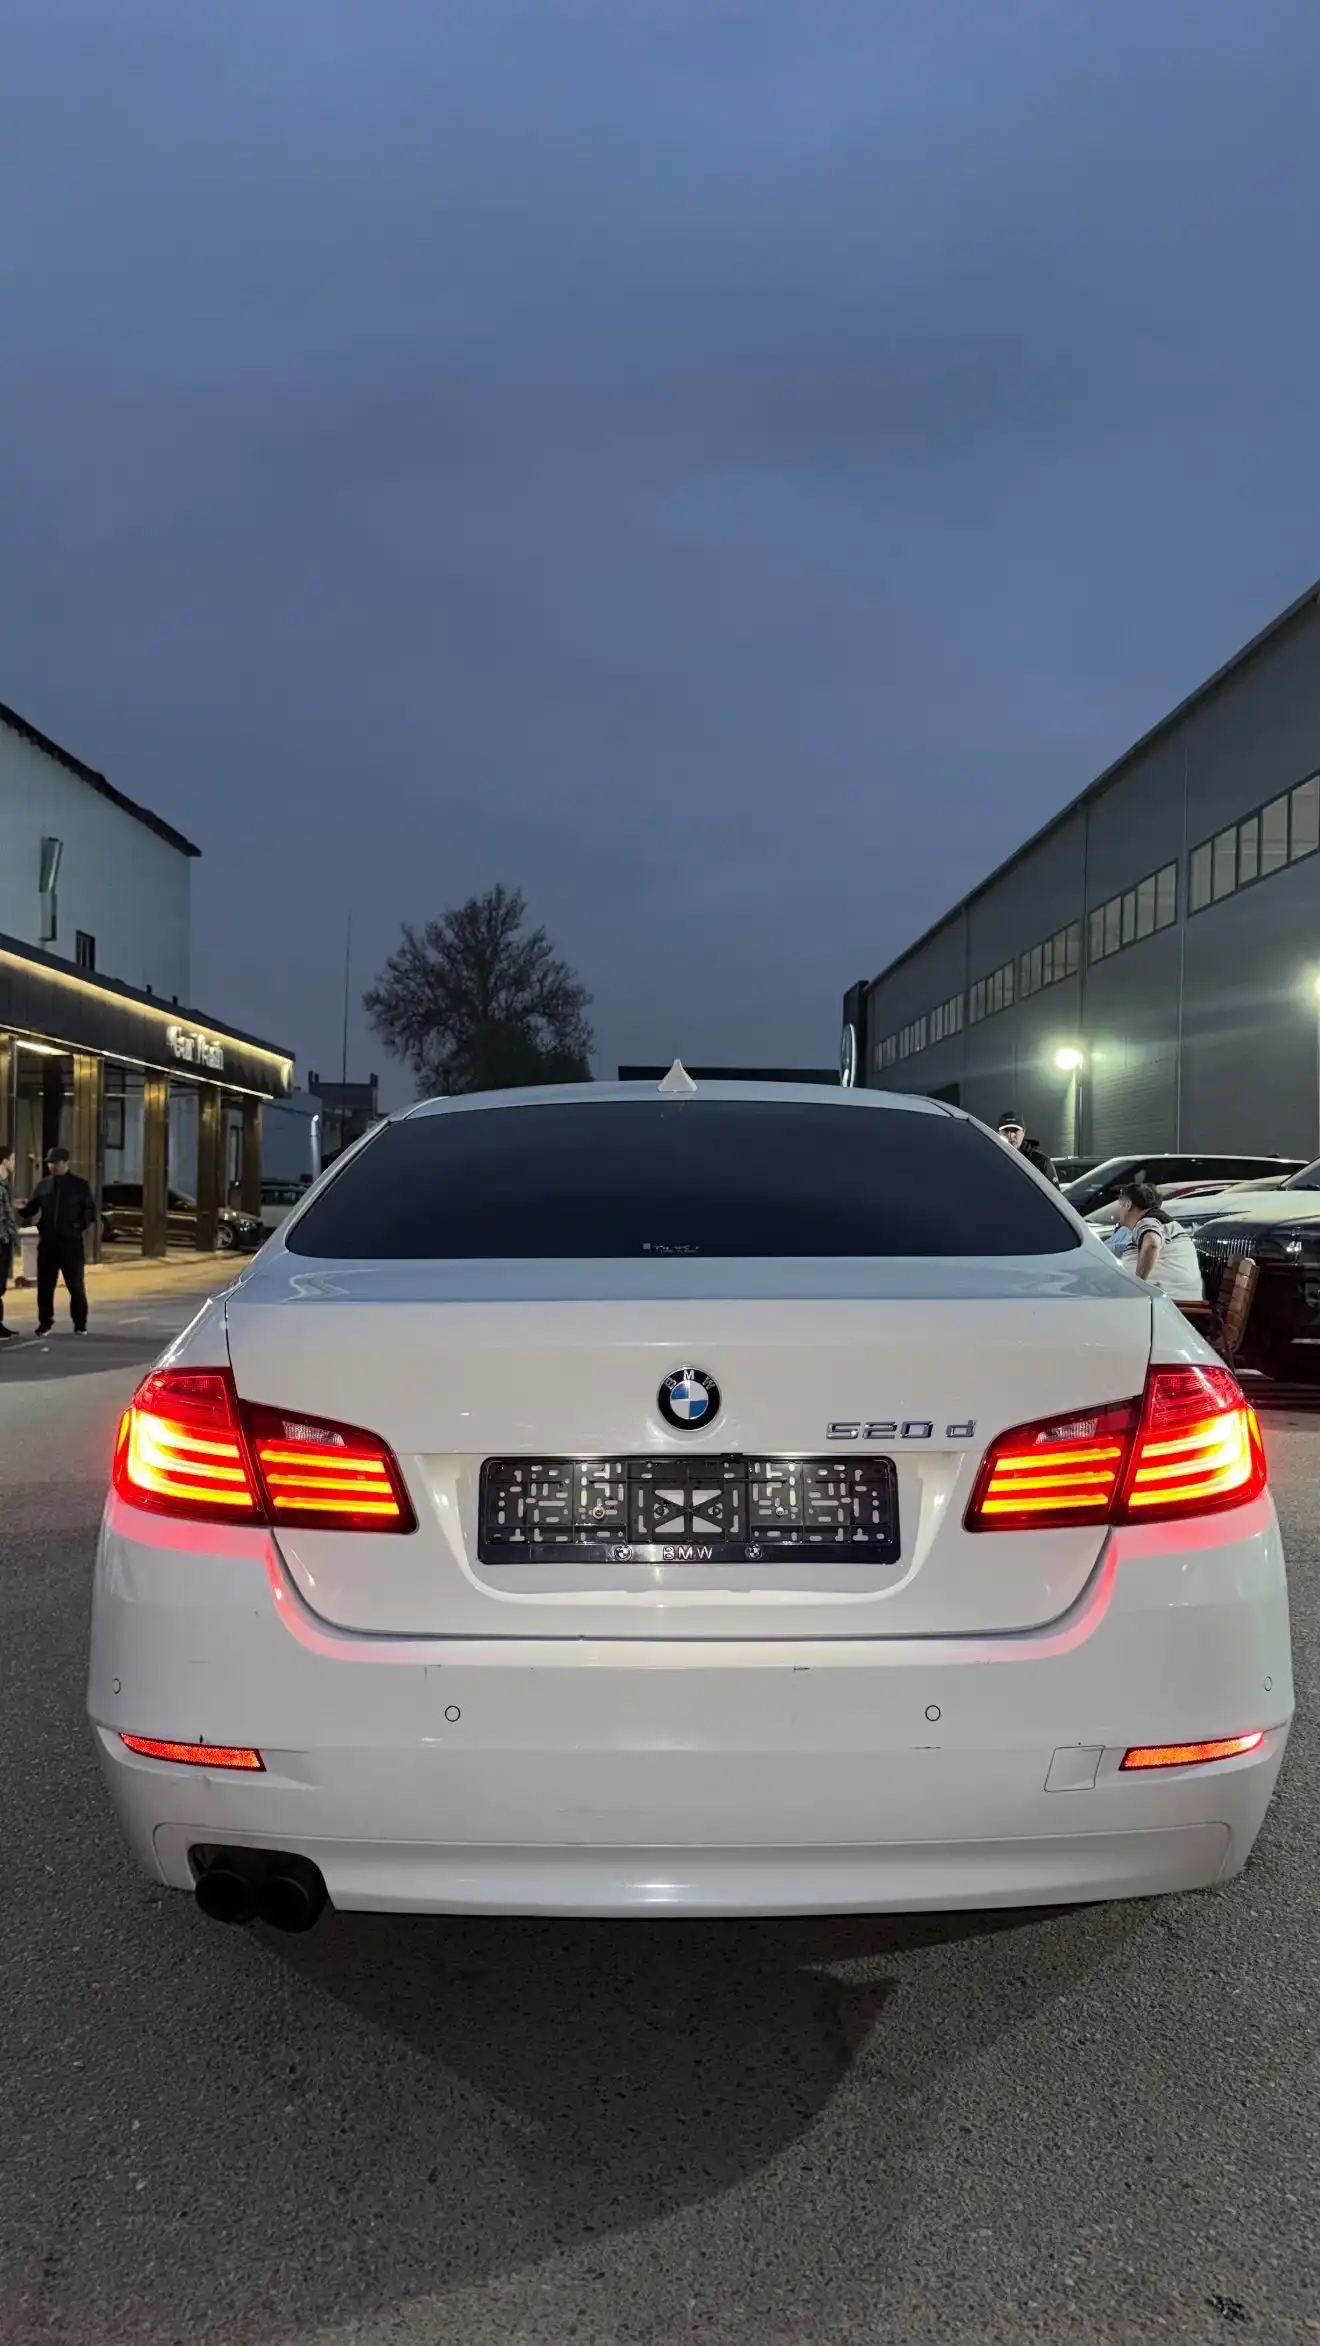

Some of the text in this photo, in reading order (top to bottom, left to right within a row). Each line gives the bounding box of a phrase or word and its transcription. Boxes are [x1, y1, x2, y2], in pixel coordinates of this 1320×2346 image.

[664, 1369, 716, 1390] BMW
[826, 1420, 976, 1439] 520 d
[662, 1545, 713, 1560] BMW
